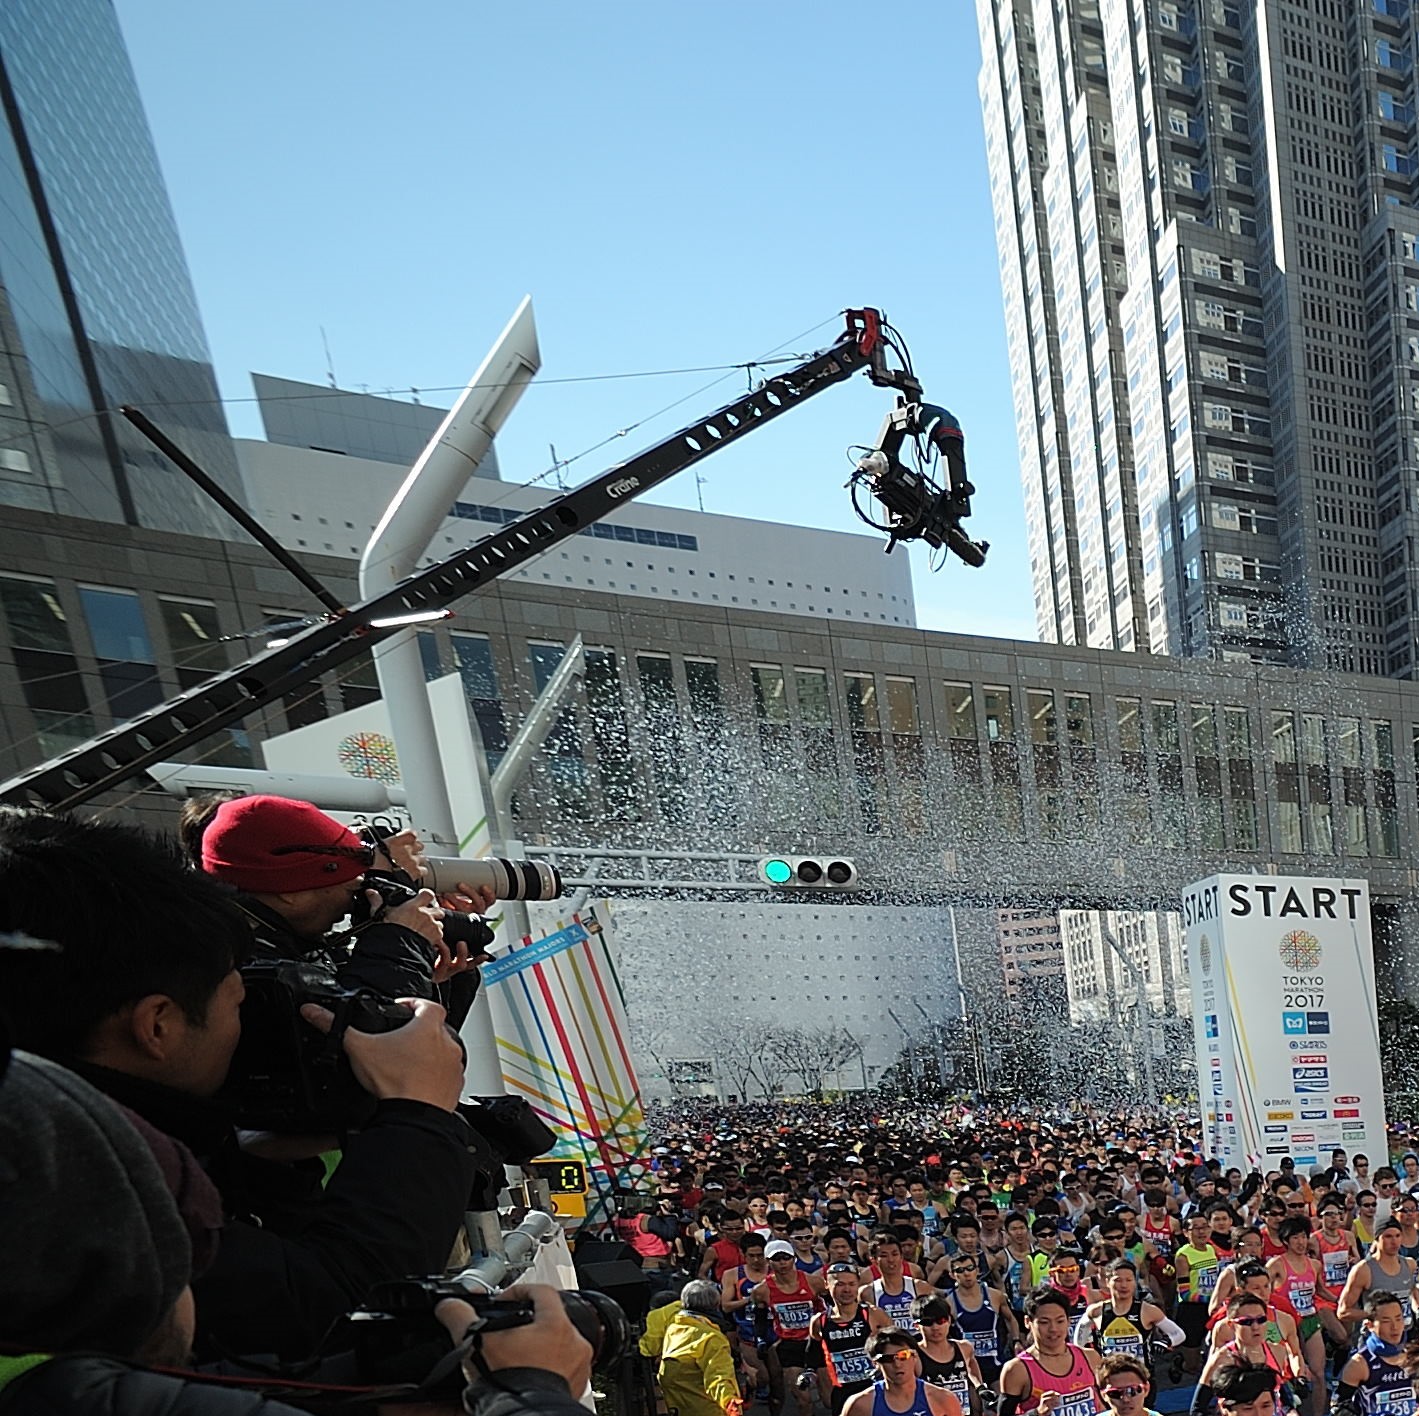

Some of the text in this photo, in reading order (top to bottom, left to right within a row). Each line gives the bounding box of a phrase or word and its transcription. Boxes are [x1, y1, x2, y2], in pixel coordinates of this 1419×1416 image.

[1185, 885, 1218, 927] START
[1229, 884, 1361, 920] START
[1282, 976, 1324, 986] TOKYO
[1284, 995, 1324, 1008] 2017
[835, 1359, 870, 1375] A4553
